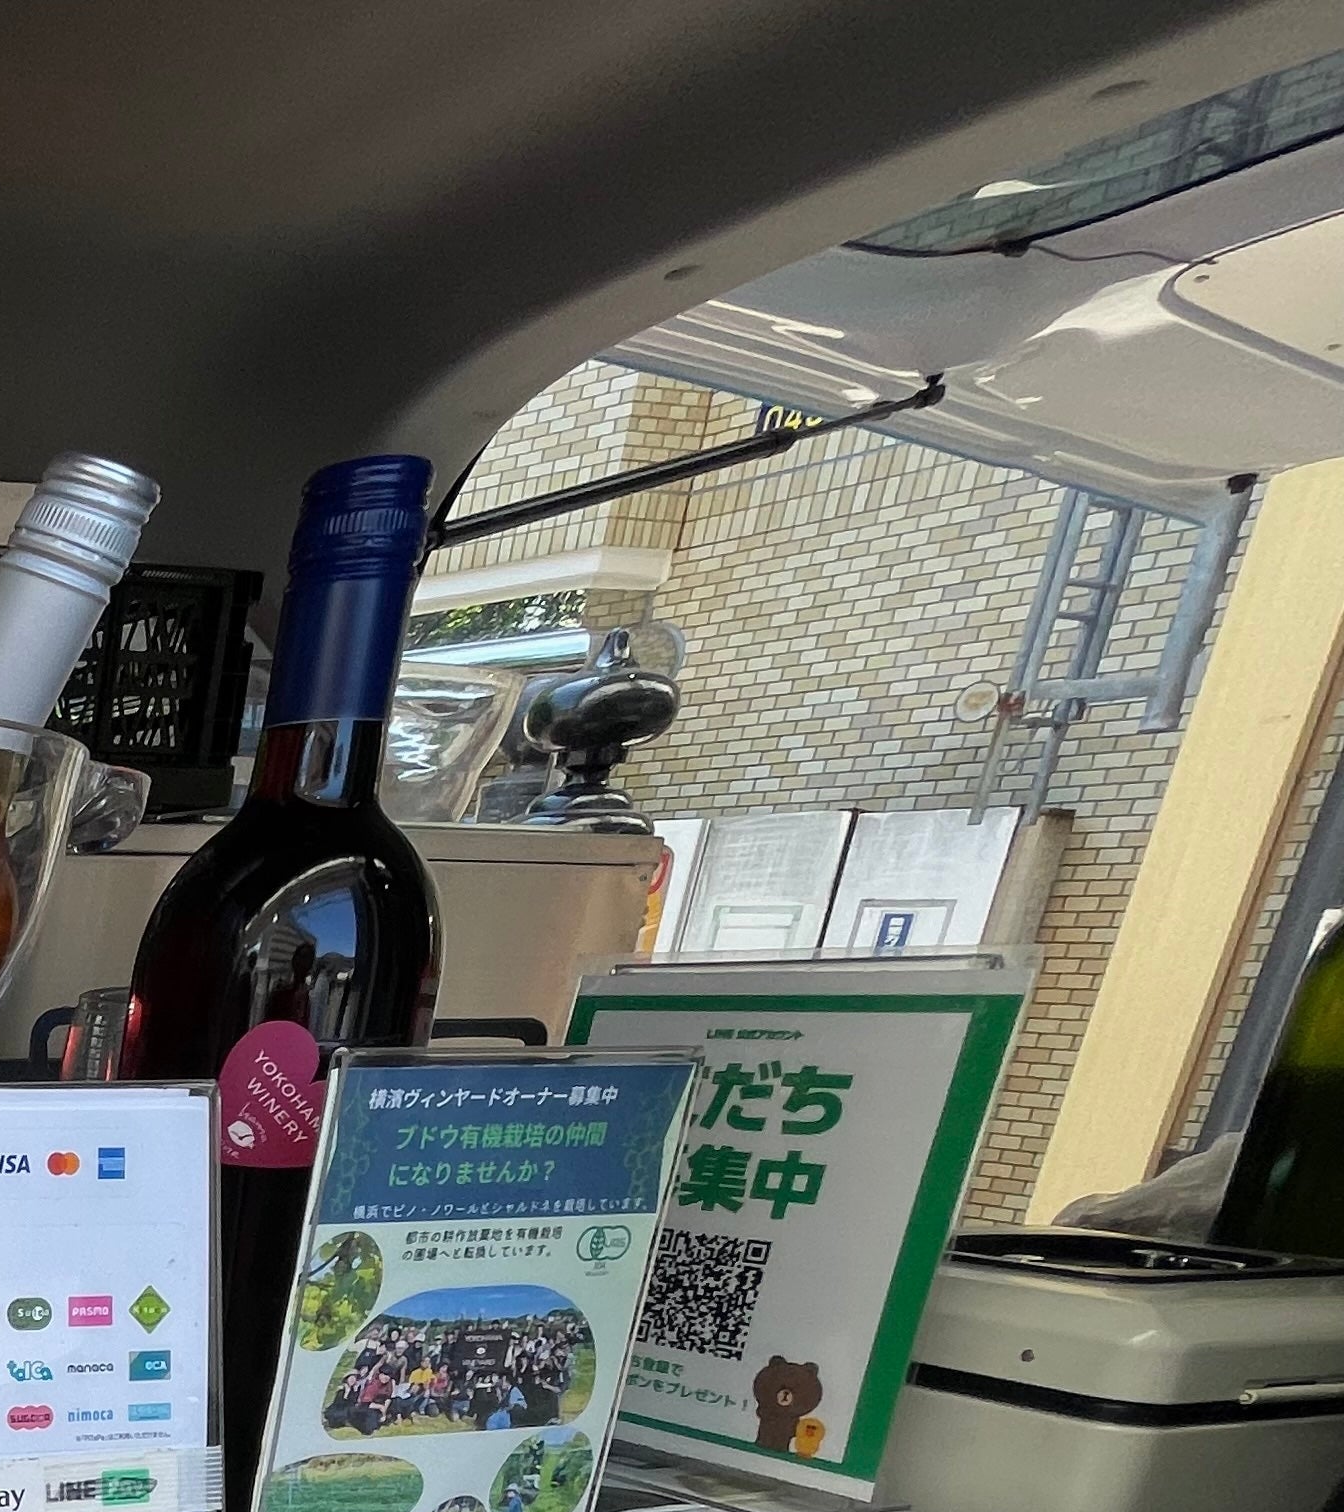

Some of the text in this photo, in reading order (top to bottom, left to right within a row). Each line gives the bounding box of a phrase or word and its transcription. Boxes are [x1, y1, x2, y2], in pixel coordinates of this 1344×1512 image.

[254, 1049, 321, 1133] YOKOHAM
[698, 1060, 854, 1135] だち
[247, 1077, 309, 1144] WINERY
[396, 1121, 608, 1151] ブドウ有機栽培の仲間
[389, 1160, 556, 1187] になりませんか？
[677, 1144, 828, 1220] 集中
[72, 1307, 110, 1316] PASMO
[67, 1363, 114, 1374] manaca
[67, 1408, 114, 1423] nimoca
